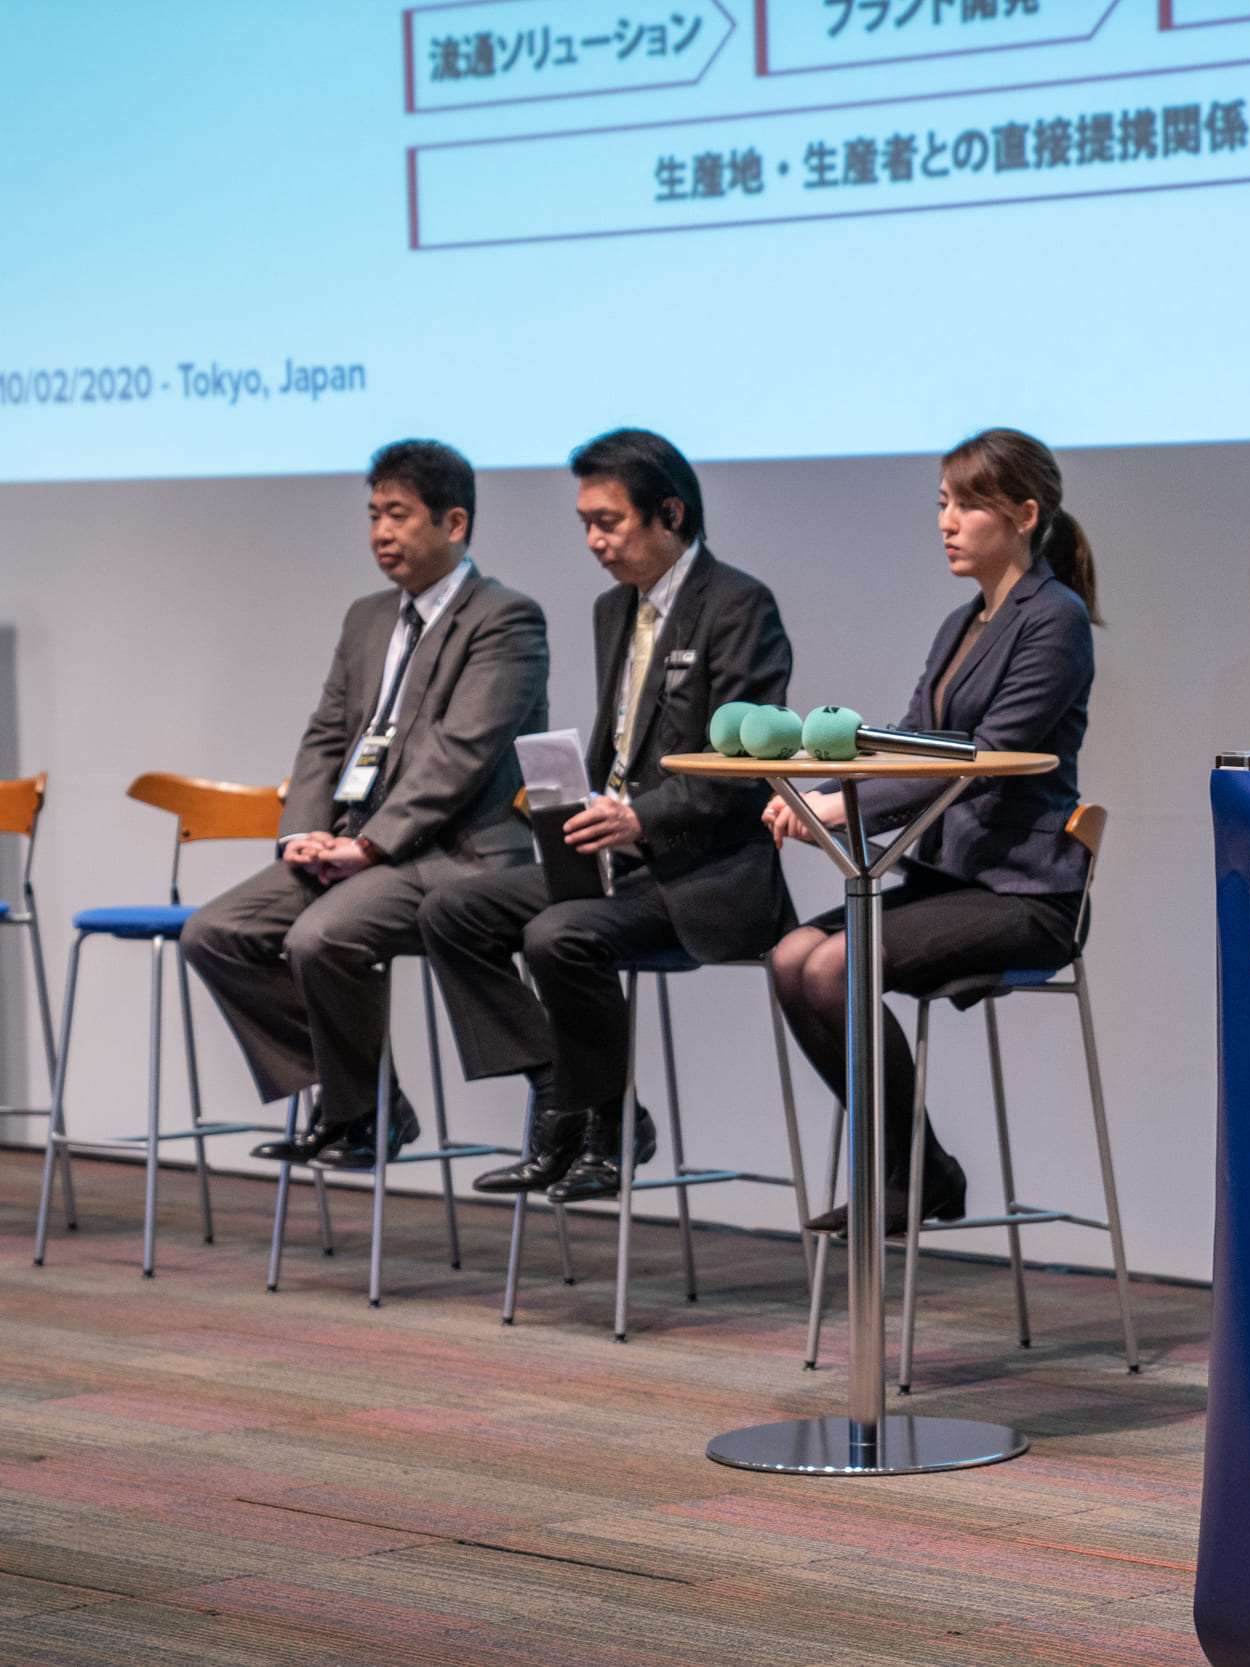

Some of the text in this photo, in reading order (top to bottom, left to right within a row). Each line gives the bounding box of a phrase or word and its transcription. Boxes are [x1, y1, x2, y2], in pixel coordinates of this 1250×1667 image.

[429, 12, 703, 82] 流通ソリューション
[654, 98, 1248, 201] 生産地・生産者との直接提携関係
[178, 361, 269, 405] Tokyo,
[280, 357, 366, 401] Japan
